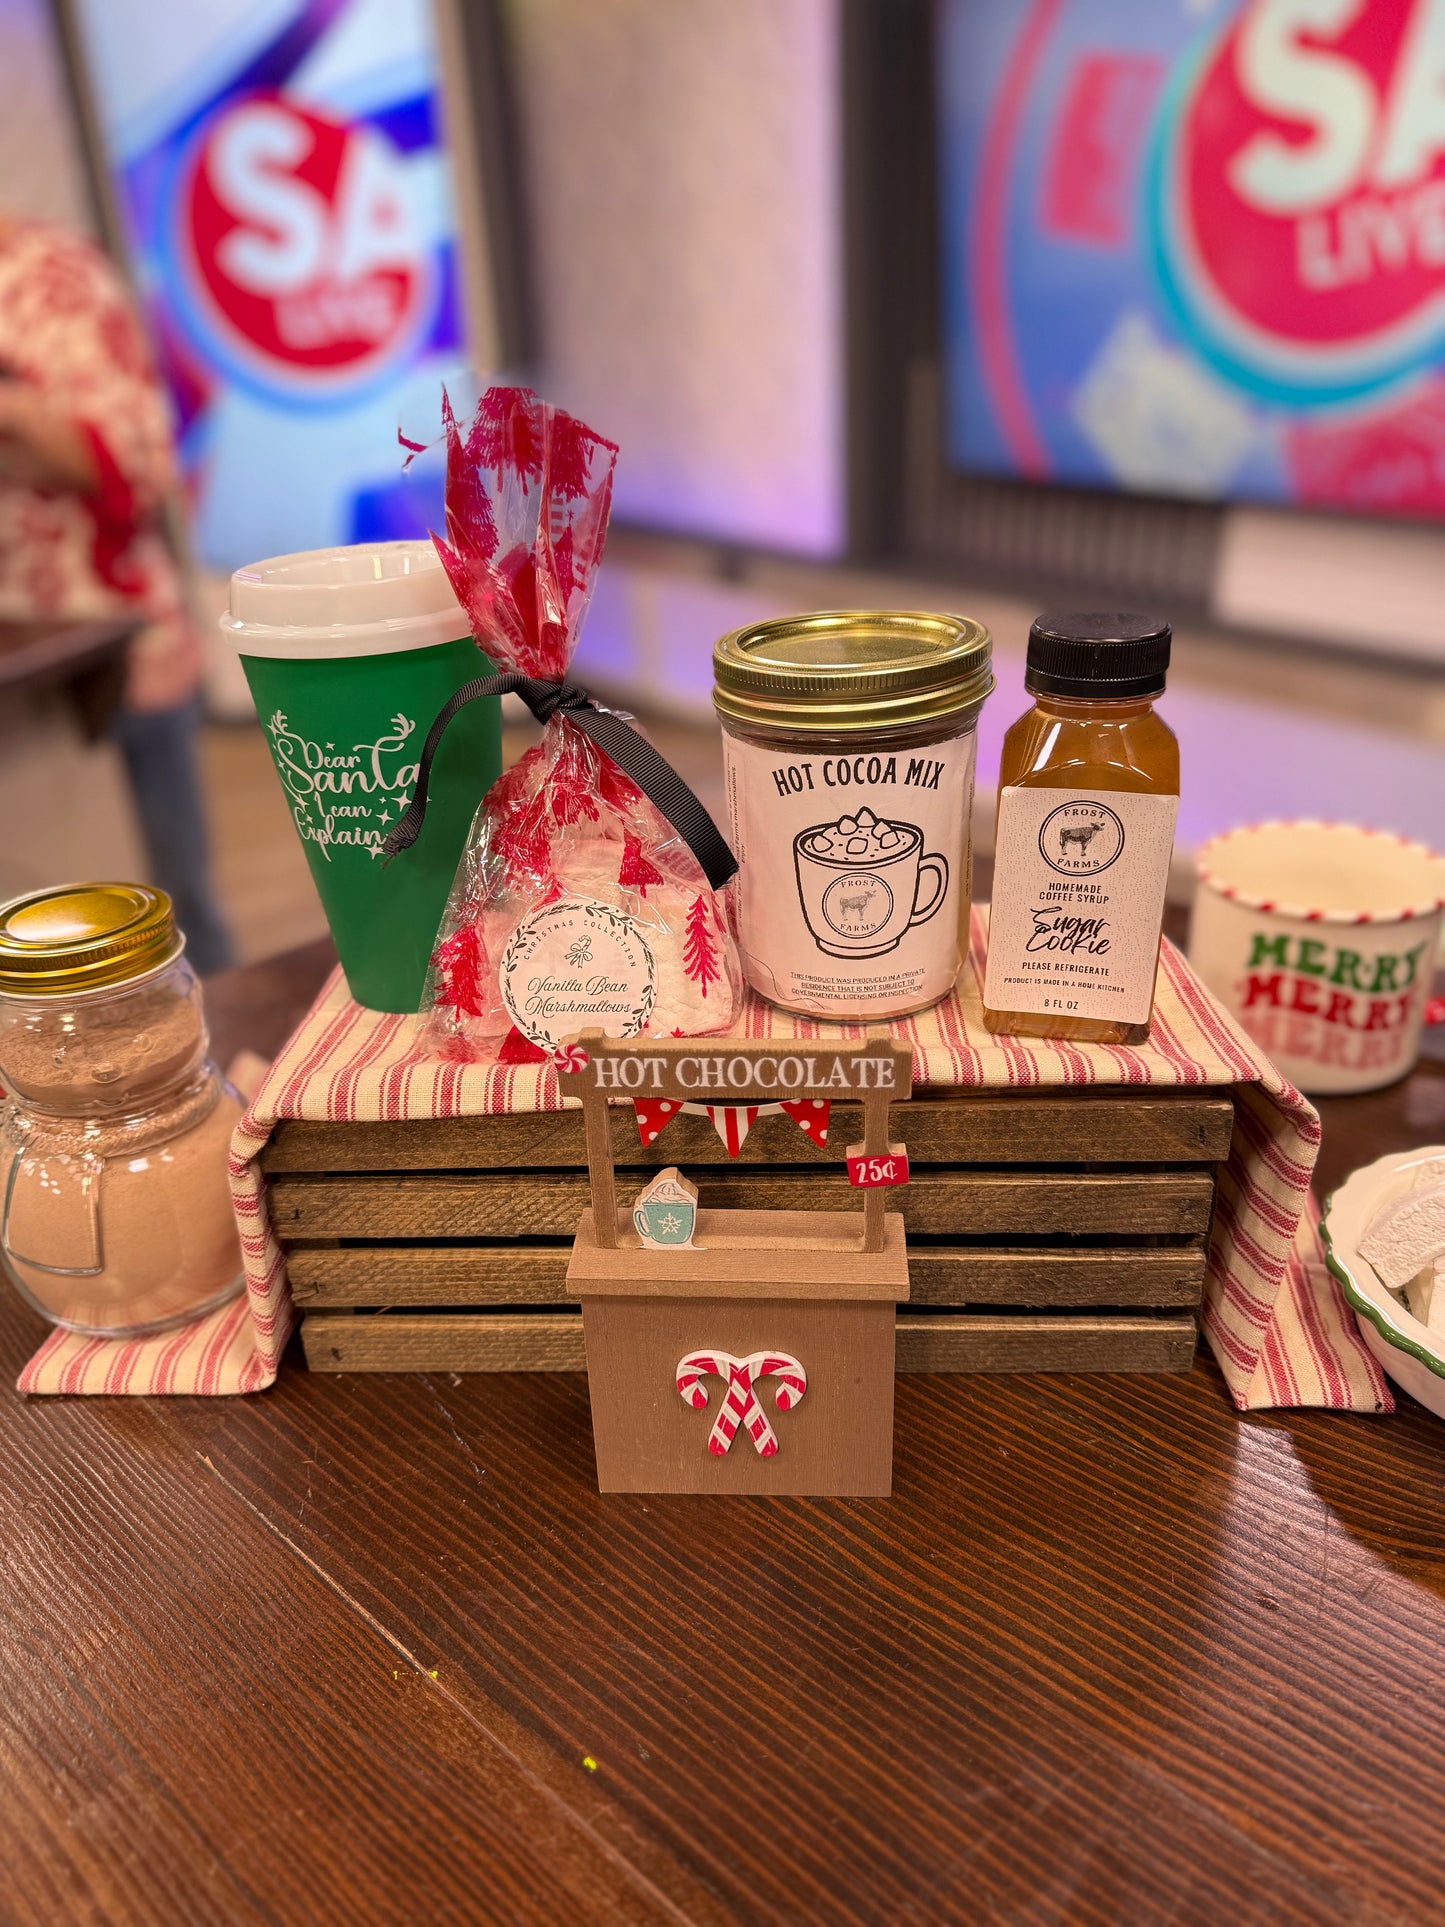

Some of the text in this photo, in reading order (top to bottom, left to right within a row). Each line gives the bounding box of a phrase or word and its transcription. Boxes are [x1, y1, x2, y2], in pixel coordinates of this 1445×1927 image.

[205, 104, 424, 292] SA
[277, 737, 421, 794] Santa
[302, 741, 361, 770] Dear
[771, 757, 946, 797] HOT COCOA MIX
[330, 804, 373, 818] can
[1064, 808, 1106, 819] FROST
[294, 806, 388, 862] Explain
[1056, 858, 1101, 868] FARMS
[840, 879, 877, 888] FROST
[1048, 882, 1102, 895] HOMEMADE
[1039, 891, 1110, 904] COFFEE SYRUP
[839, 922, 877, 932] FARMS
[1029, 905, 1111, 940] Sugar
[523, 919, 637, 967] CHRISTMAS COLLECTION
[1025, 926, 1112, 956] Cookie
[1021, 961, 1110, 977] PLEASE REFRIGERATE
[1246, 932, 1429, 993] MERRY
[527, 975, 629, 996] Vanilla Bean
[790, 971, 805, 980] THIS
[805, 975, 834, 983] PRODUCT
[852, 976, 887, 984] PRODUCED
[901, 968, 926, 978] PRIVATE
[801, 982, 835, 992] RESIDENCE
[878, 980, 908, 990] SUBJECT
[791, 988, 841, 1000] GOVERNMENTAL
[888, 985, 923, 997] INSPECTION
[1077, 982, 1096, 990] HOME
[1097, 984, 1125, 993] KITCHEN
[524, 996, 632, 1019] Marshmallows
[1044, 998, 1079, 1010] 8 FL OZ
[1241, 971, 1418, 1032] MERRY
[593, 1056, 896, 1089] HOT CHOCOLATE
[855, 1159, 898, 1185] 25¢
